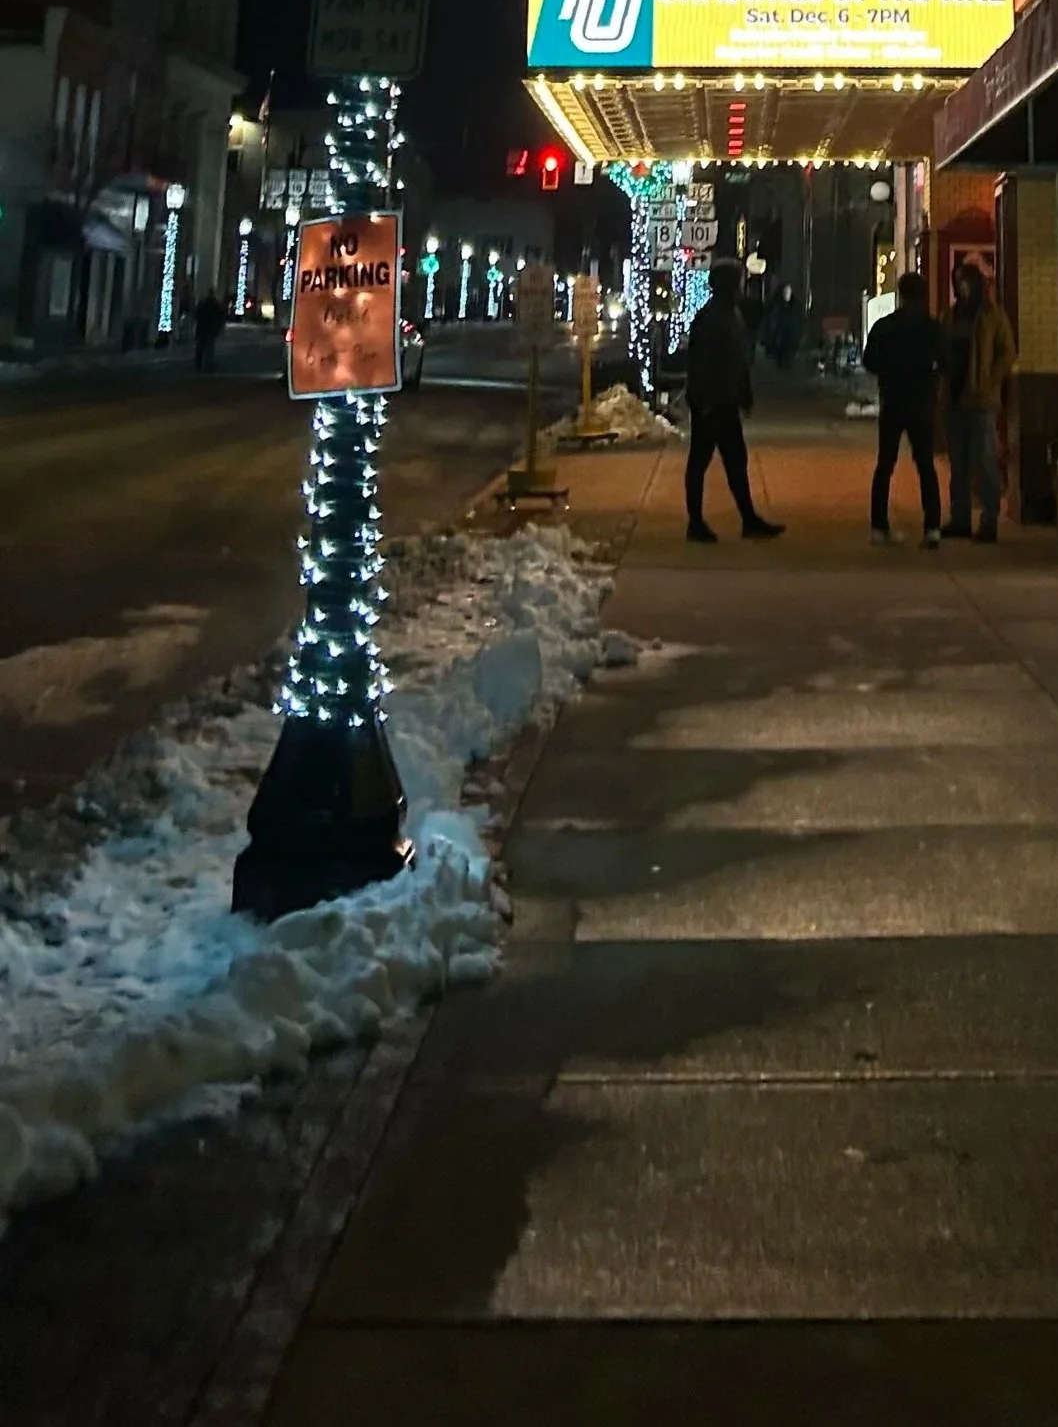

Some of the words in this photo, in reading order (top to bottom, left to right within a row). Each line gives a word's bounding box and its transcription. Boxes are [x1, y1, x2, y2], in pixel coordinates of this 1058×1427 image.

[838, 7, 850, 23] 6
[867, 7, 911, 24] 7PM
[654, 225, 670, 242] 18
[690, 226, 710, 242] 101
[330, 235, 359, 259] NO
[300, 262, 391, 294] PARKING
